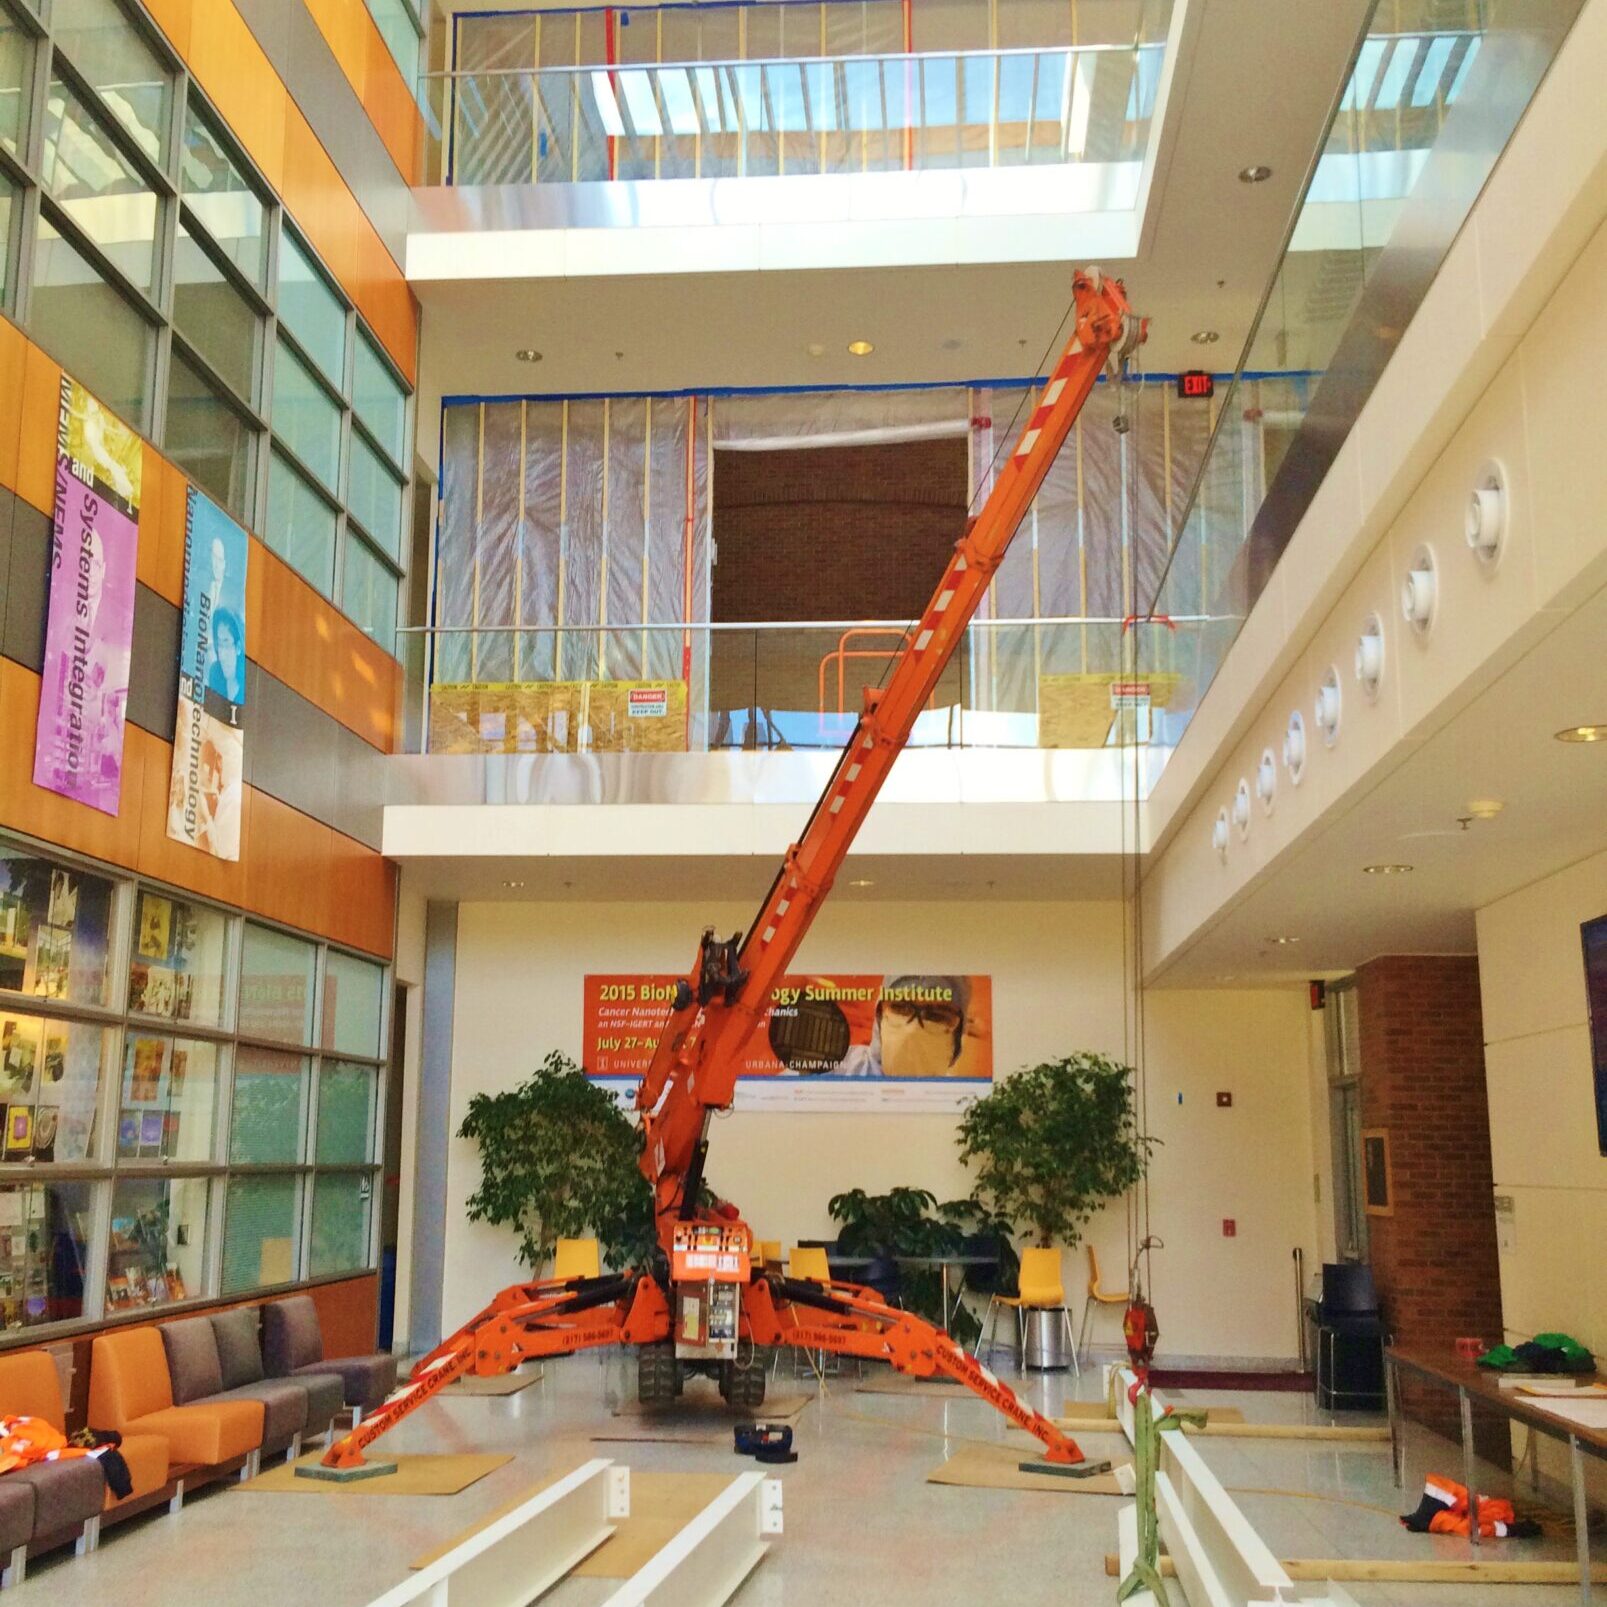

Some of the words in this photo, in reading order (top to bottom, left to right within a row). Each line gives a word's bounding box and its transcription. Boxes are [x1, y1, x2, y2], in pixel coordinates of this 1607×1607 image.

[72, 458, 95, 488] and
[75, 493, 98, 618] Systems
[180, 676, 193, 697] nd
[633, 693, 662, 701] DANGER
[67, 625, 91, 788] Integration
[599, 984, 636, 1001] 2015
[641, 984, 678, 1001] BioN
[771, 987, 801, 1006] ogy
[805, 984, 875, 1002] Summer
[880, 984, 953, 1002] Institute
[598, 1007, 630, 1017] Cancer
[610, 1020, 653, 1028] NSF-IGERT
[597, 1037, 622, 1052] July
[614, 1059, 652, 1069] UNIVER
[937, 1345, 968, 1373] CUSTOM
[968, 1370, 1001, 1402] SERVICE
[1002, 1398, 1031, 1426] CRANE
[358, 1413, 391, 1449] CUSTOM
[393, 1384, 428, 1420] SERVICE
[428, 1361, 456, 1389] CRANE
